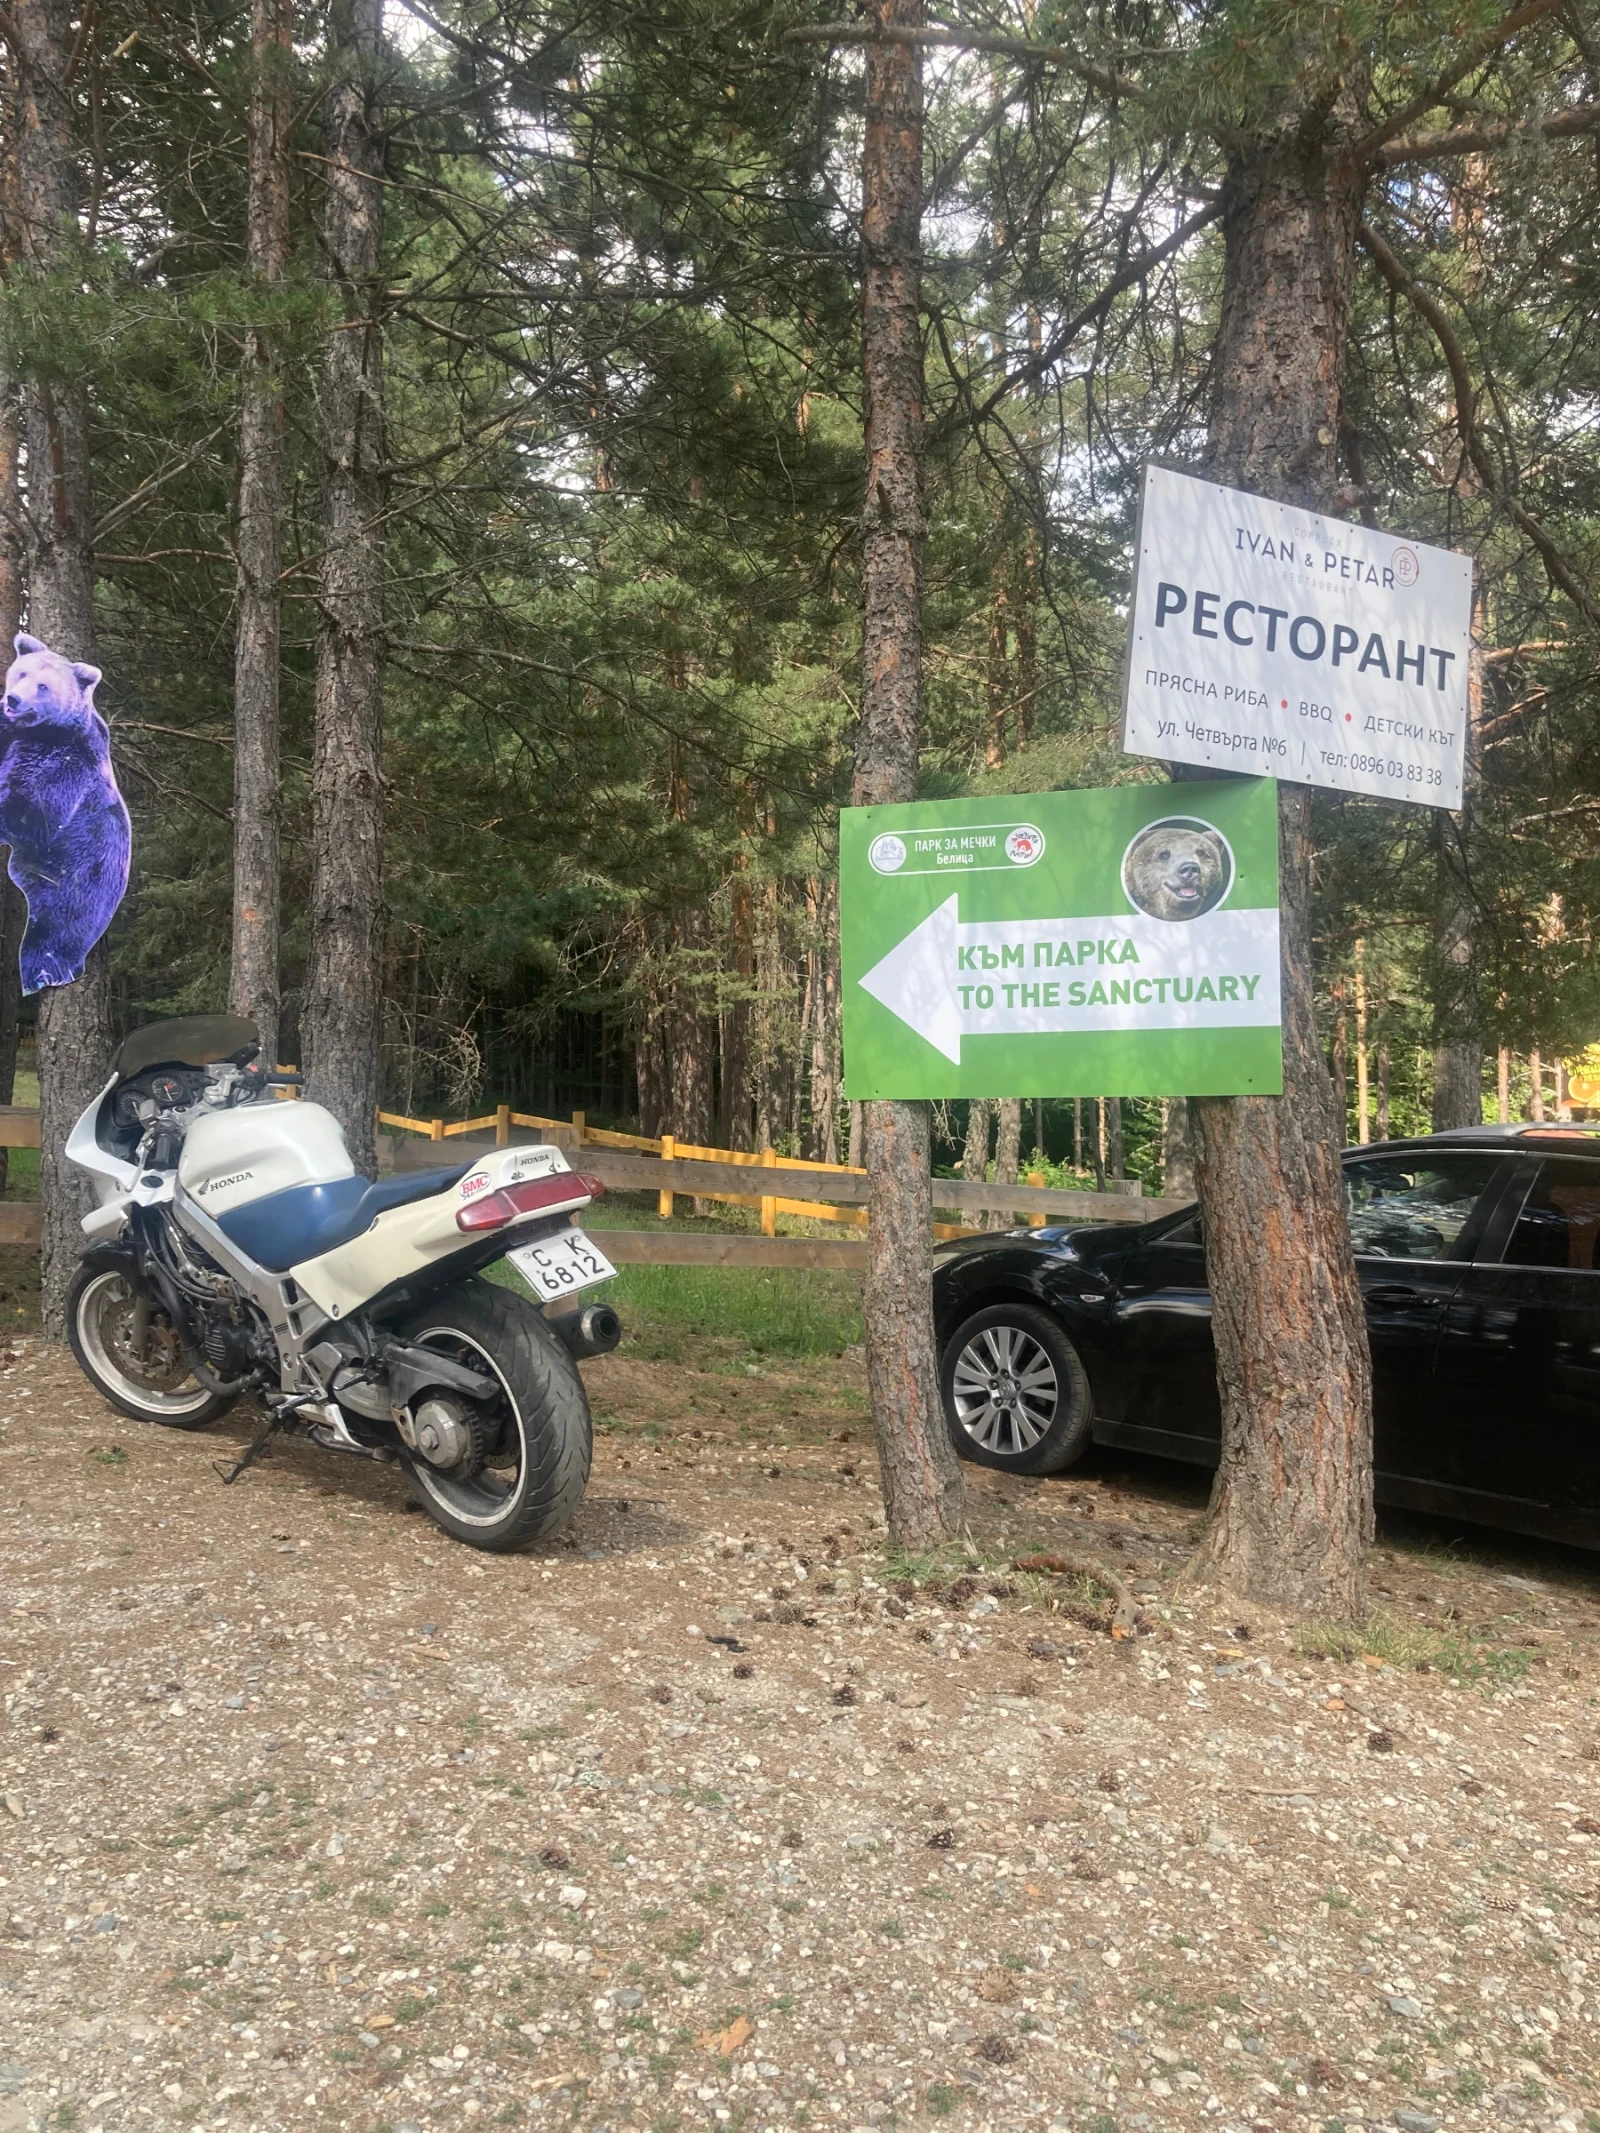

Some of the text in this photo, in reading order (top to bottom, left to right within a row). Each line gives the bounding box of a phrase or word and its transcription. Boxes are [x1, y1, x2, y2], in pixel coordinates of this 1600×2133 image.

[1294, 527, 1342, 548] COMPLEX
[1235, 527, 1295, 564] IVAN
[1304, 552, 1315, 568] &
[1324, 552, 1395, 590] PETAR
[1282, 571, 1354, 597] RESTAURANT
[1154, 582, 1456, 691] РЕСТОРАНТ
[1145, 669, 1456, 747] ПРЯСНА РИБА BBQ ДЕТСКИ КЪТ
[1157, 720, 1442, 786] ул. Четвърта №6 тел: 0896 03 83 38
[914, 835, 996, 852] ПАРК ЗА МЕЧКИ
[936, 853, 973, 865] Белица
[957, 939, 1140, 971] КЪМ ПАРКА
[957, 975, 1261, 1010] TO THE SANCTUARY
[520, 1154, 551, 1166] HONDA
[209, 1171, 254, 1192] HONDA
[462, 1175, 488, 1194] BMC
[542, 1256, 605, 1290] 6812
